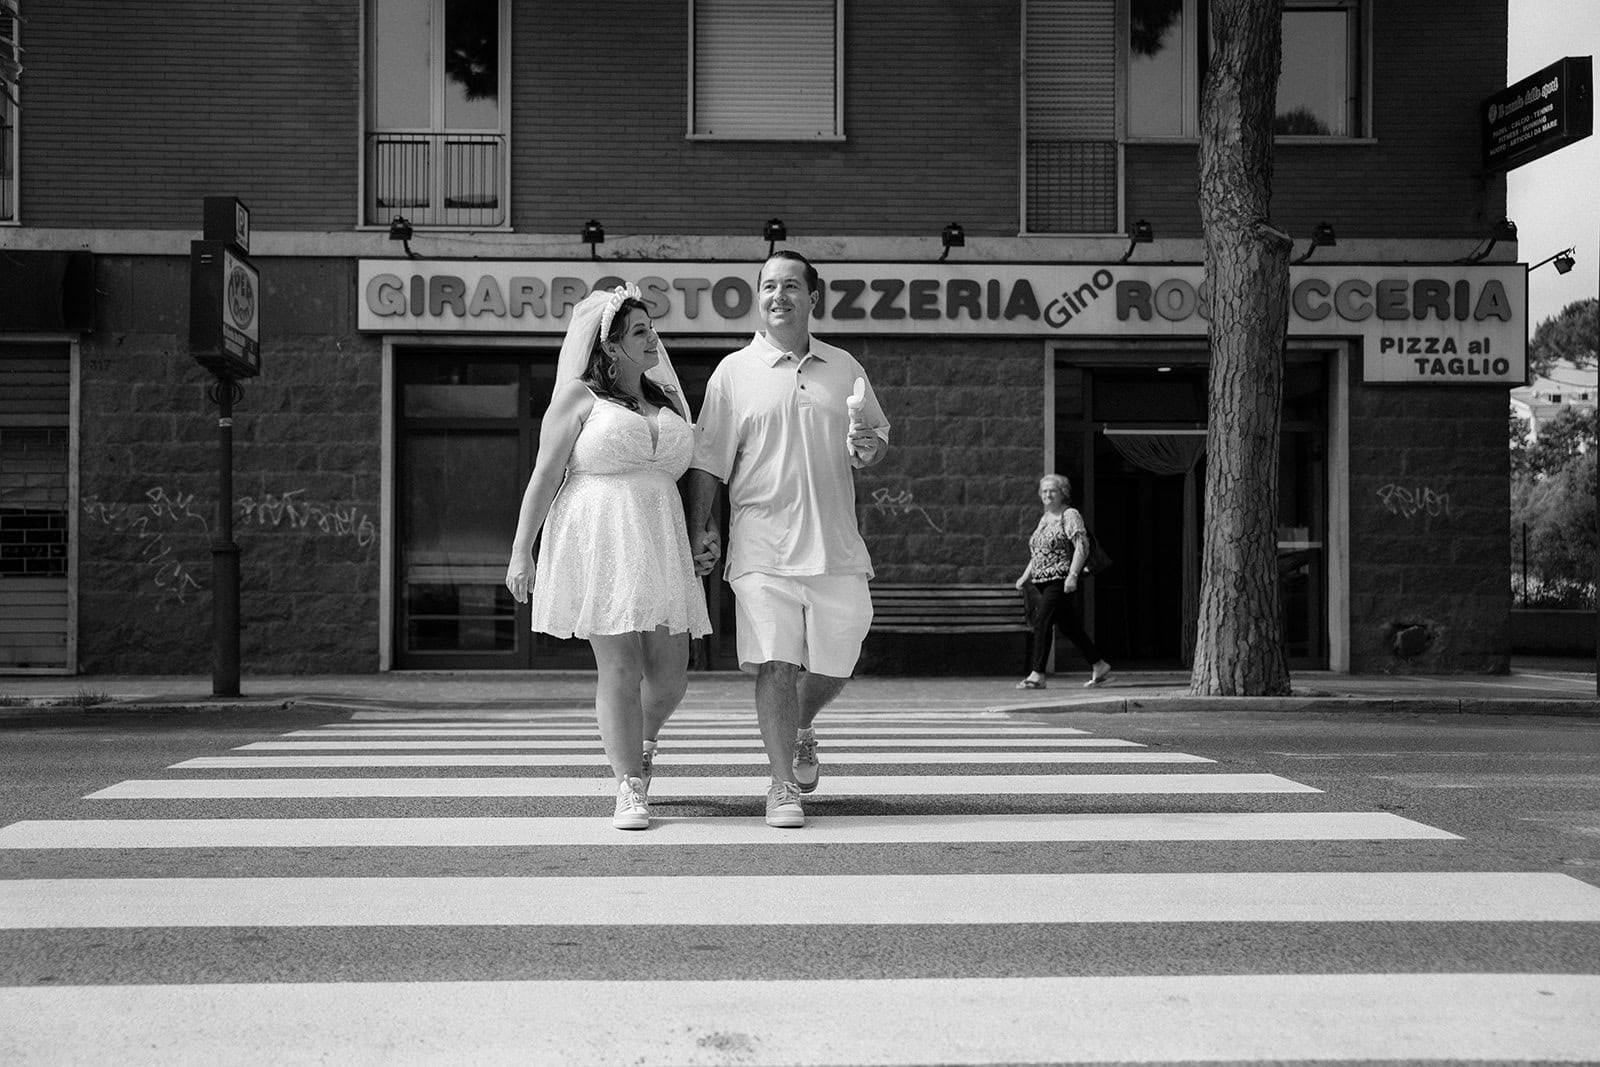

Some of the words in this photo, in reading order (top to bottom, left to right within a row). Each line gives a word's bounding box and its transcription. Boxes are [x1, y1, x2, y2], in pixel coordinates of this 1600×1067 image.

[1511, 115, 1530, 129] CALCIO
[1534, 103, 1553, 118] TENNIS
[1510, 131, 1533, 146] ARTICOLI
[1542, 119, 1557, 132] MARE
[813, 278, 1041, 322] IZZERIA
[1043, 269, 1114, 329] Gino
[1116, 278, 1512, 322] ROCCERIA
[1380, 336, 1458, 355] PIZZA
[1468, 337, 1490, 355] al
[1415, 357, 1511, 376] TAGLIO
